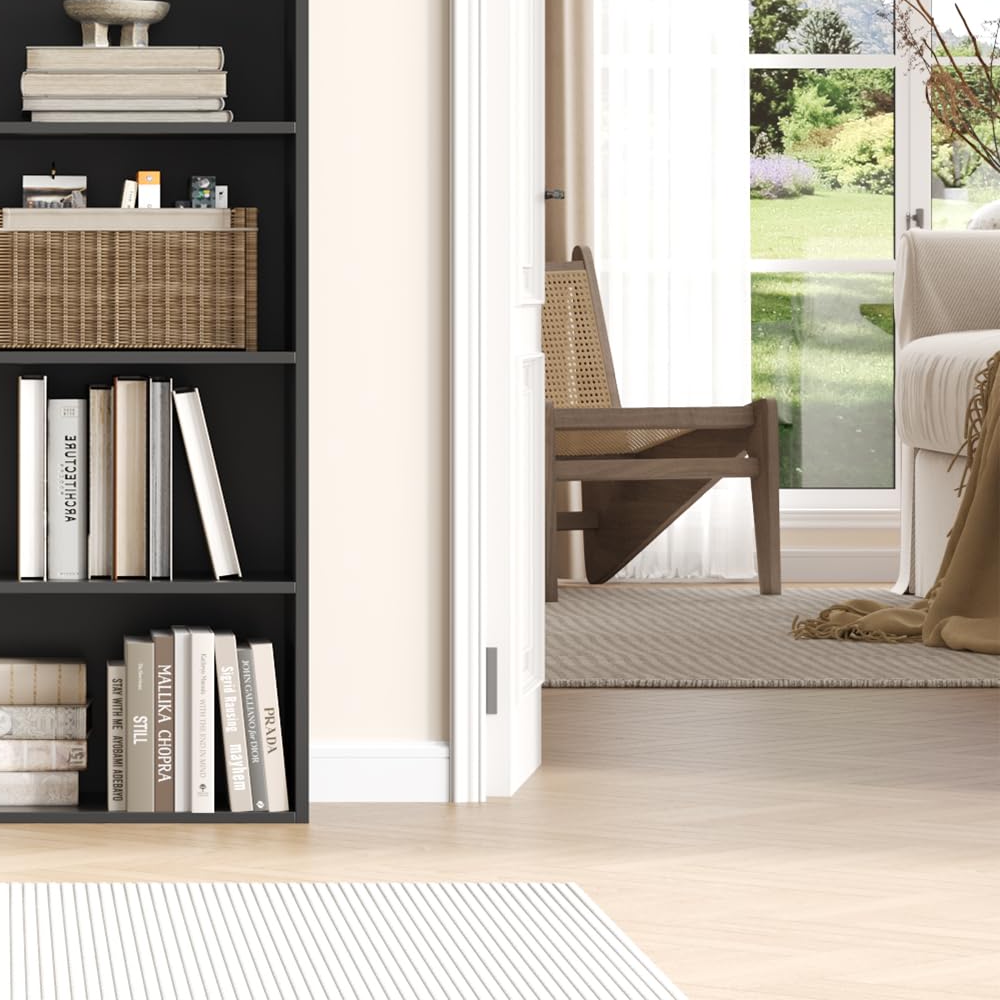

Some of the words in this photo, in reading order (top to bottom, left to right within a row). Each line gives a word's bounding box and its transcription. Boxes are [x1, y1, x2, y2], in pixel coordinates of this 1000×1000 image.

[112, 678, 123, 695] STAY
[220, 665, 235, 693] Sigrid
[241, 659, 250, 683] JOHN
[112, 697, 123, 717] WITH
[157, 664, 172, 723] MALLIKA
[112, 718, 123, 730] ME
[223, 695, 238, 732] Rausing
[132, 715, 148, 745] STILL
[263, 706, 278, 754] PRADA
[112, 735, 123, 767] AYOBAMI
[157, 729, 172, 783] CHOPRA
[229, 743, 247, 791] mayhem
[112, 769, 123, 802] ADEBAYO
